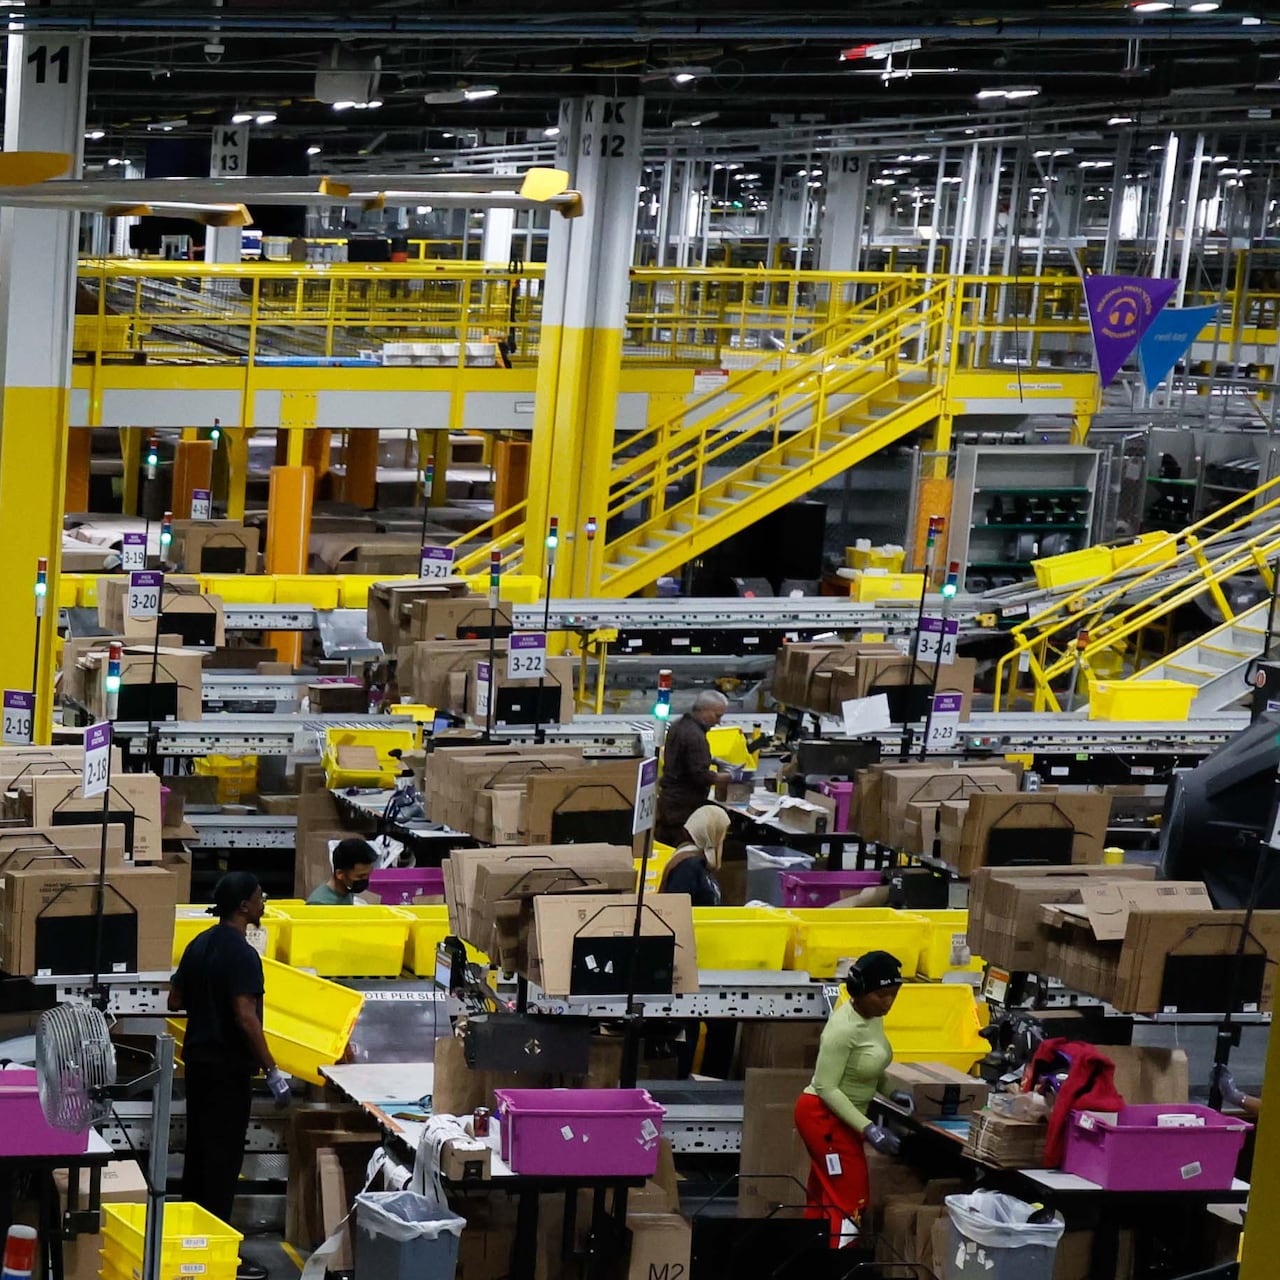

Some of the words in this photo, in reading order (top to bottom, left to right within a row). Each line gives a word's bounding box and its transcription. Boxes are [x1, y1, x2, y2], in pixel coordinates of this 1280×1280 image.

[28, 46, 70, 84] 11
[222, 130, 240, 147] K
[600, 134, 625, 158] 12
[220, 154, 240, 171] 13
[842, 155, 860, 174] 13
[124, 551, 145, 565] 3-19
[423, 564, 449, 578] 3-21
[130, 593, 158, 609] 3-20
[511, 655, 543, 673] 3-22
[4, 716, 32, 736] 2-19
[931, 727, 954, 740] 2-23
[86, 756, 107, 788] 2-18
[363, 992, 383, 1001] OTE
[388, 992, 409, 1001] PER
